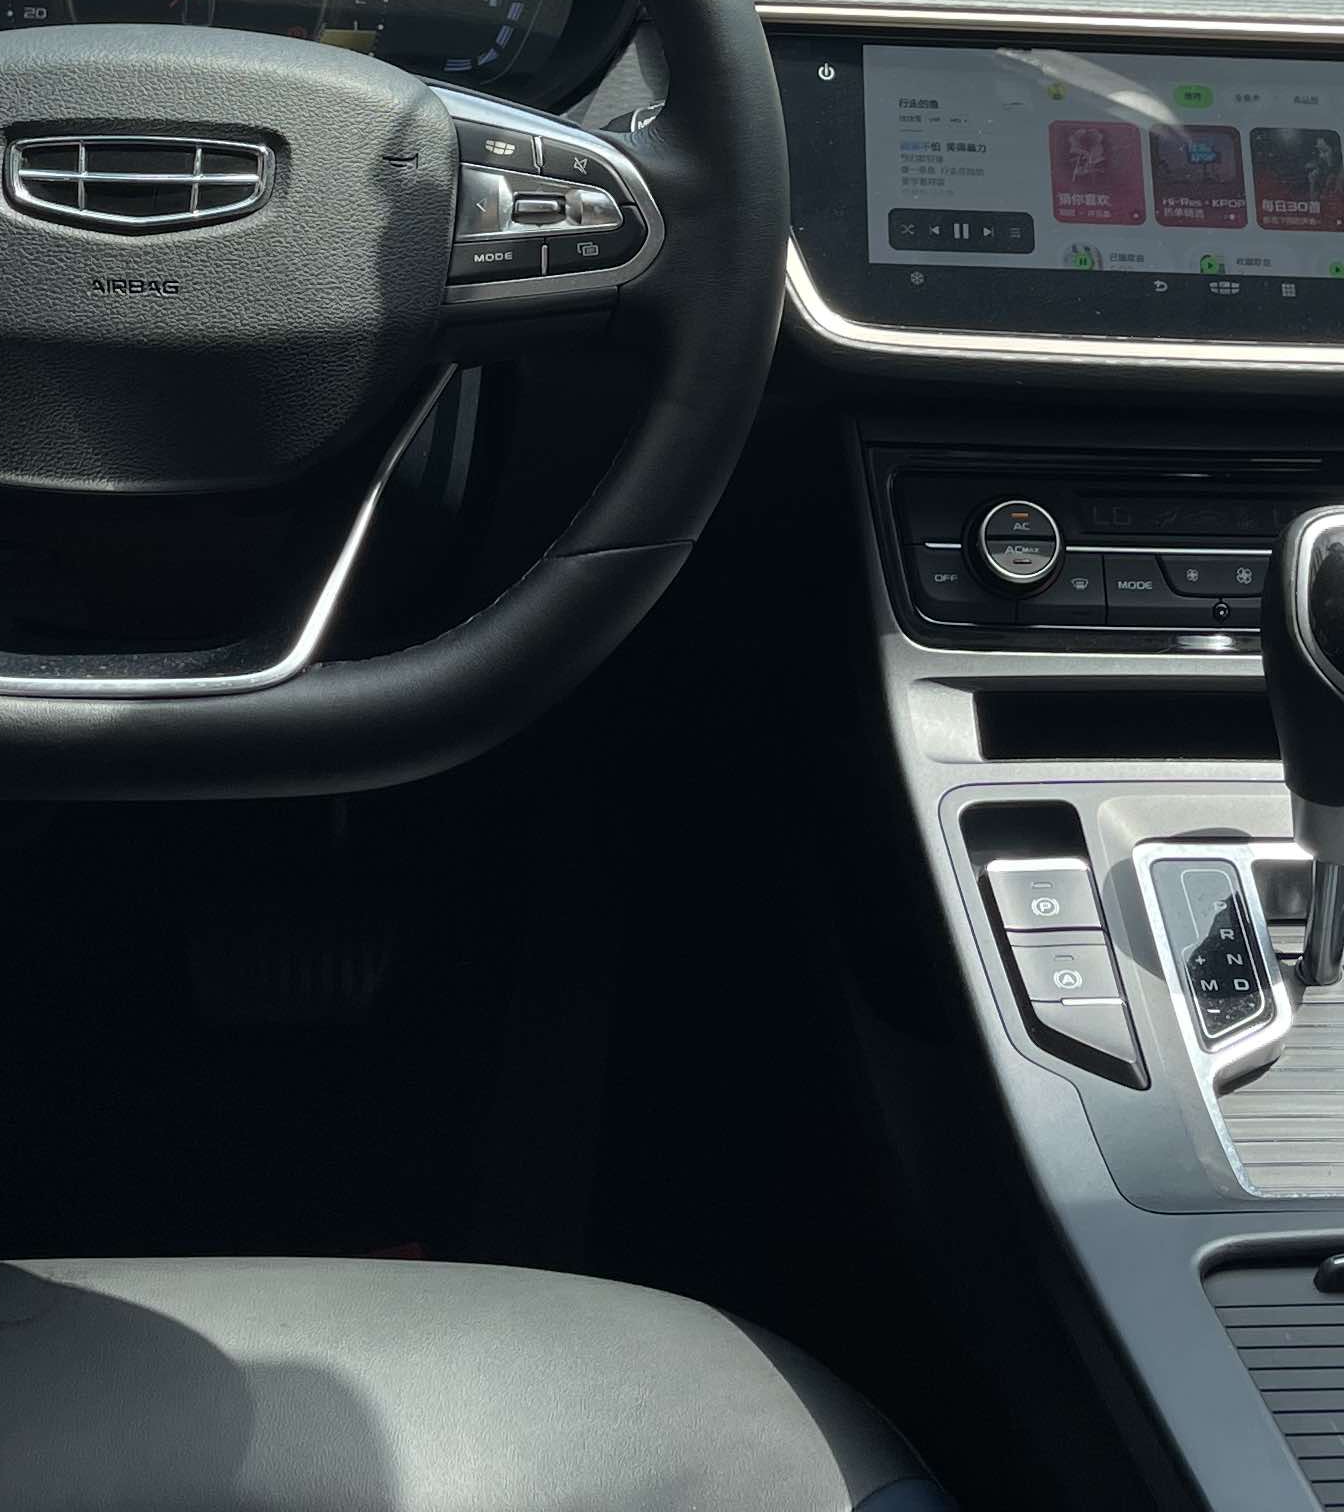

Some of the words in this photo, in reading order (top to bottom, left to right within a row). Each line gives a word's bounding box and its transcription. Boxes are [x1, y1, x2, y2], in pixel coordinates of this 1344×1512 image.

[23, 7, 47, 19] 20
[473, 251, 513, 263] MODE
[92, 279, 179, 295] AIRBAG
[1013, 522, 1031, 530] AC
[934, 574, 957, 582] OFF
[1118, 581, 1152, 590] MODE
[1213, 901, 1227, 912] P
[1219, 928, 1235, 940] R
[1226, 953, 1243, 965] N
[1200, 979, 1218, 991] M
[1233, 979, 1249, 991] D
